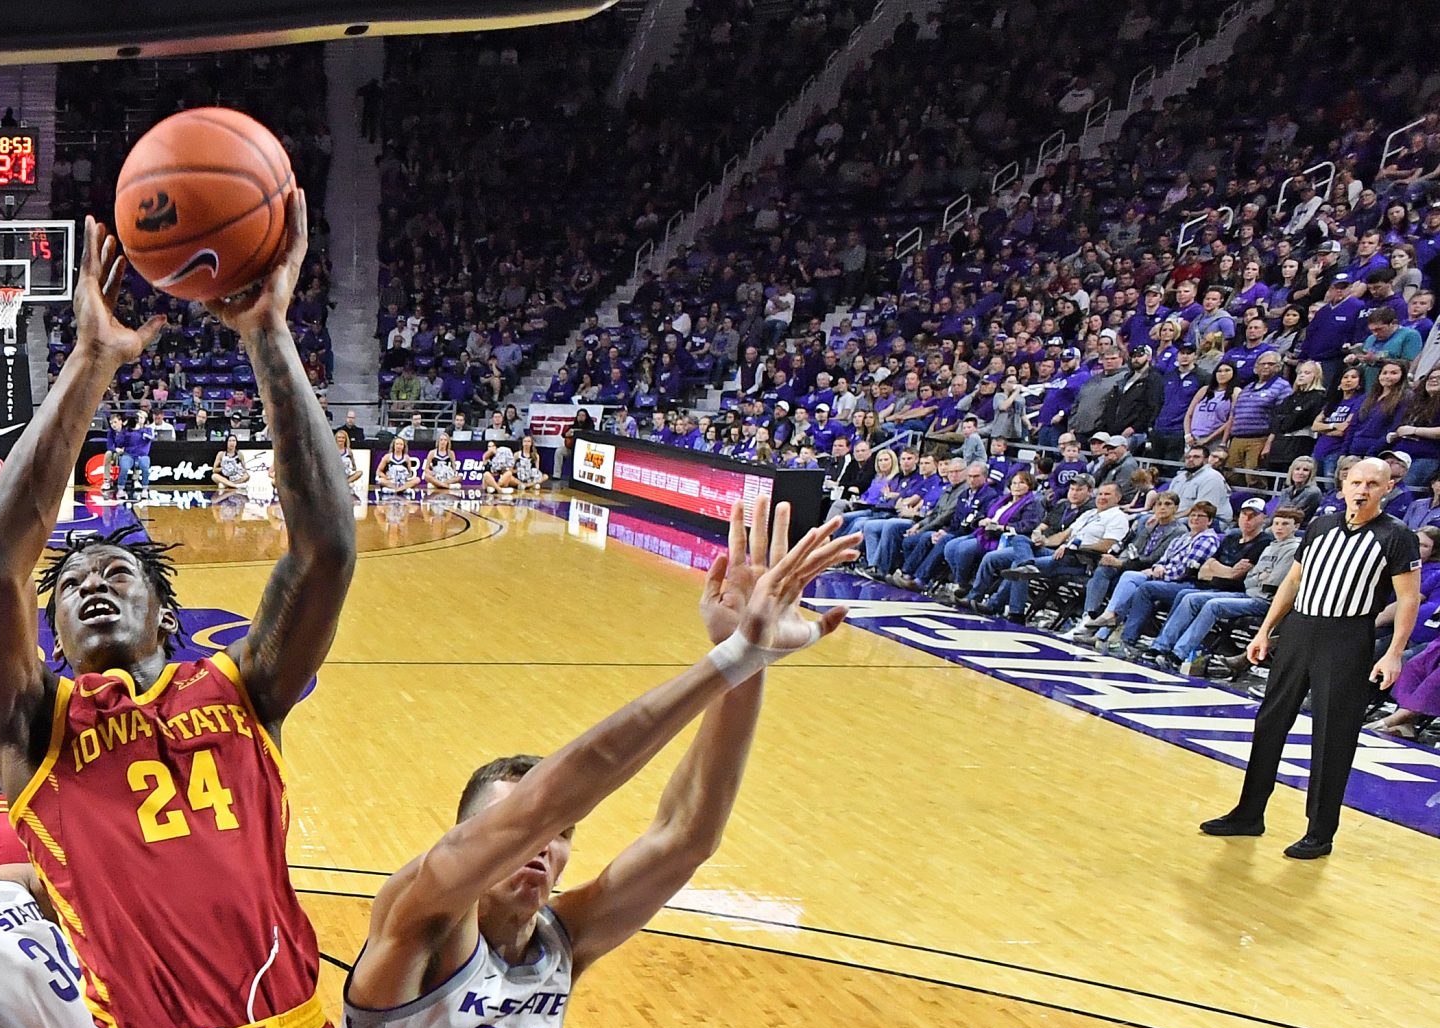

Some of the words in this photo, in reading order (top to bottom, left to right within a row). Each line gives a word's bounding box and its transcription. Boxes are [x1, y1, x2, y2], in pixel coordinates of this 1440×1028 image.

[0, 136, 32, 154] 8:53
[6, 358, 14, 421] WILDCATS
[71, 710, 152, 773] IOWA
[127, 749, 240, 844] 24
